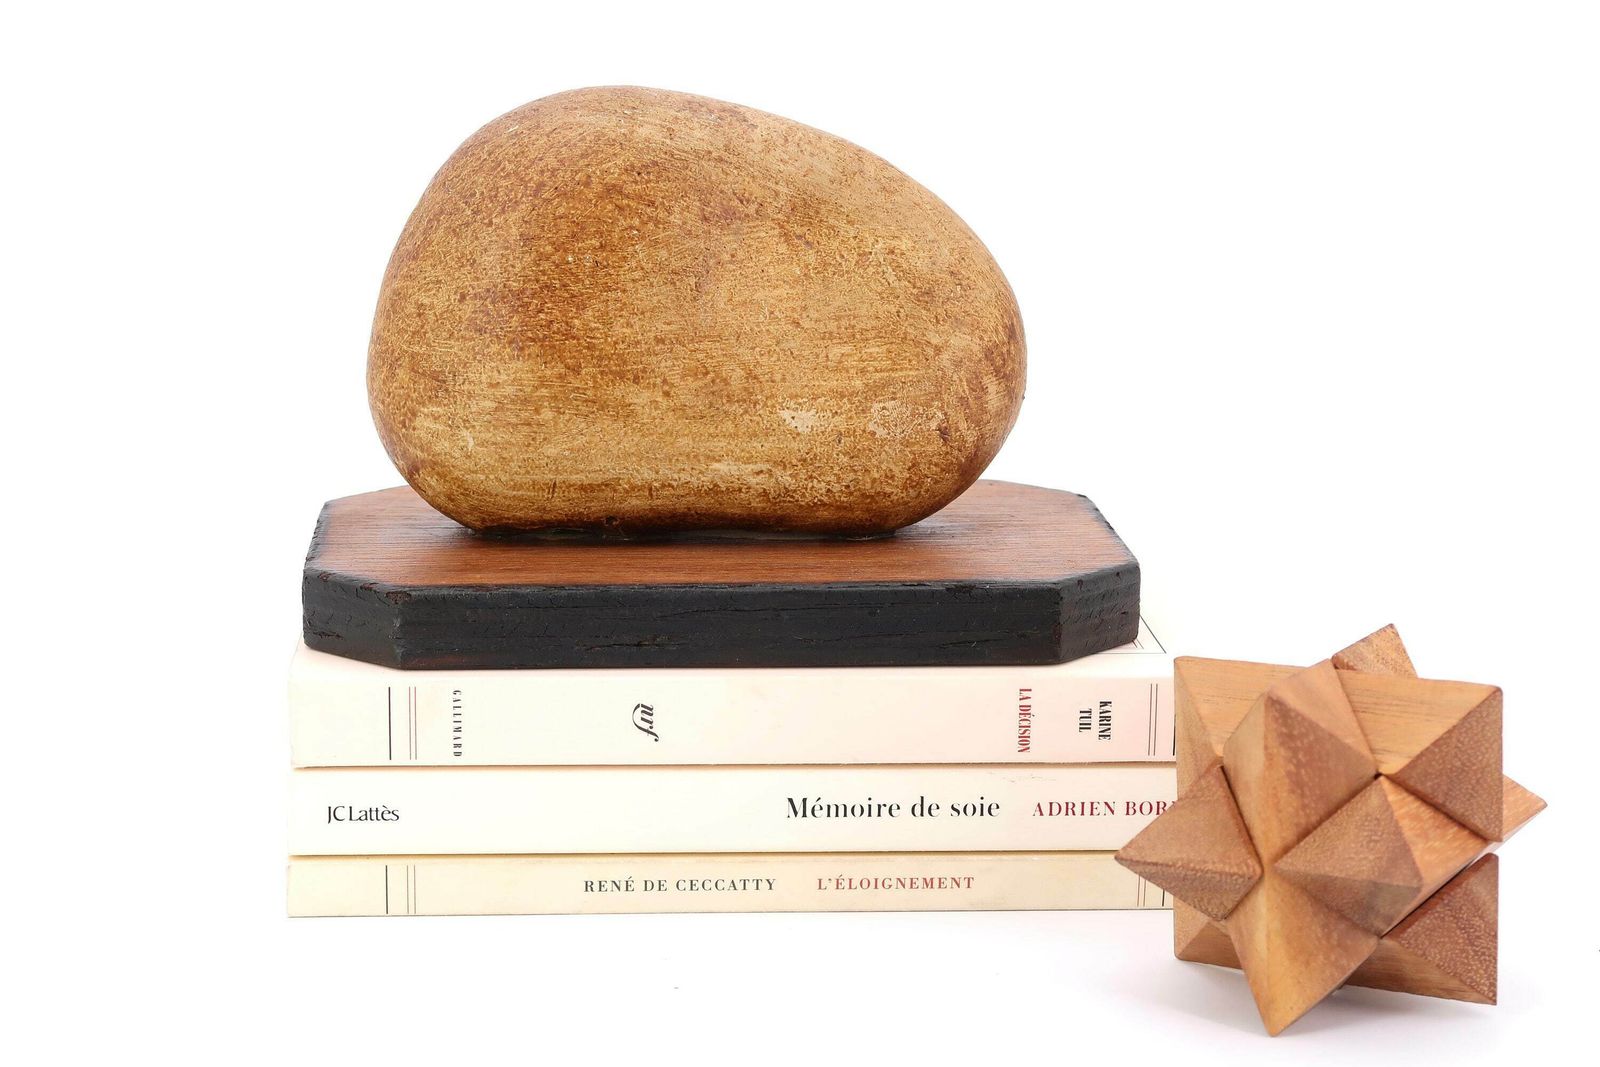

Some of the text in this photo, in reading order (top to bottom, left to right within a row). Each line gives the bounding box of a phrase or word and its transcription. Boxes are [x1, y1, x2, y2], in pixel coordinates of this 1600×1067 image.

[452, 690, 463, 757] GALLIMARD
[631, 703, 661, 743] nrf
[1017, 688, 1035, 753] LA DÉCISION
[1079, 708, 1093, 733] TUIL
[1098, 700, 1113, 741] KARINE
[786, 796, 1001, 818] Mémoire de soie
[1032, 800, 1176, 817] ADRIEN BOR
[583, 876, 777, 893] RENÉ DE CECCATTY
[817, 874, 976, 891] L'ÉLOIGNEMENT
